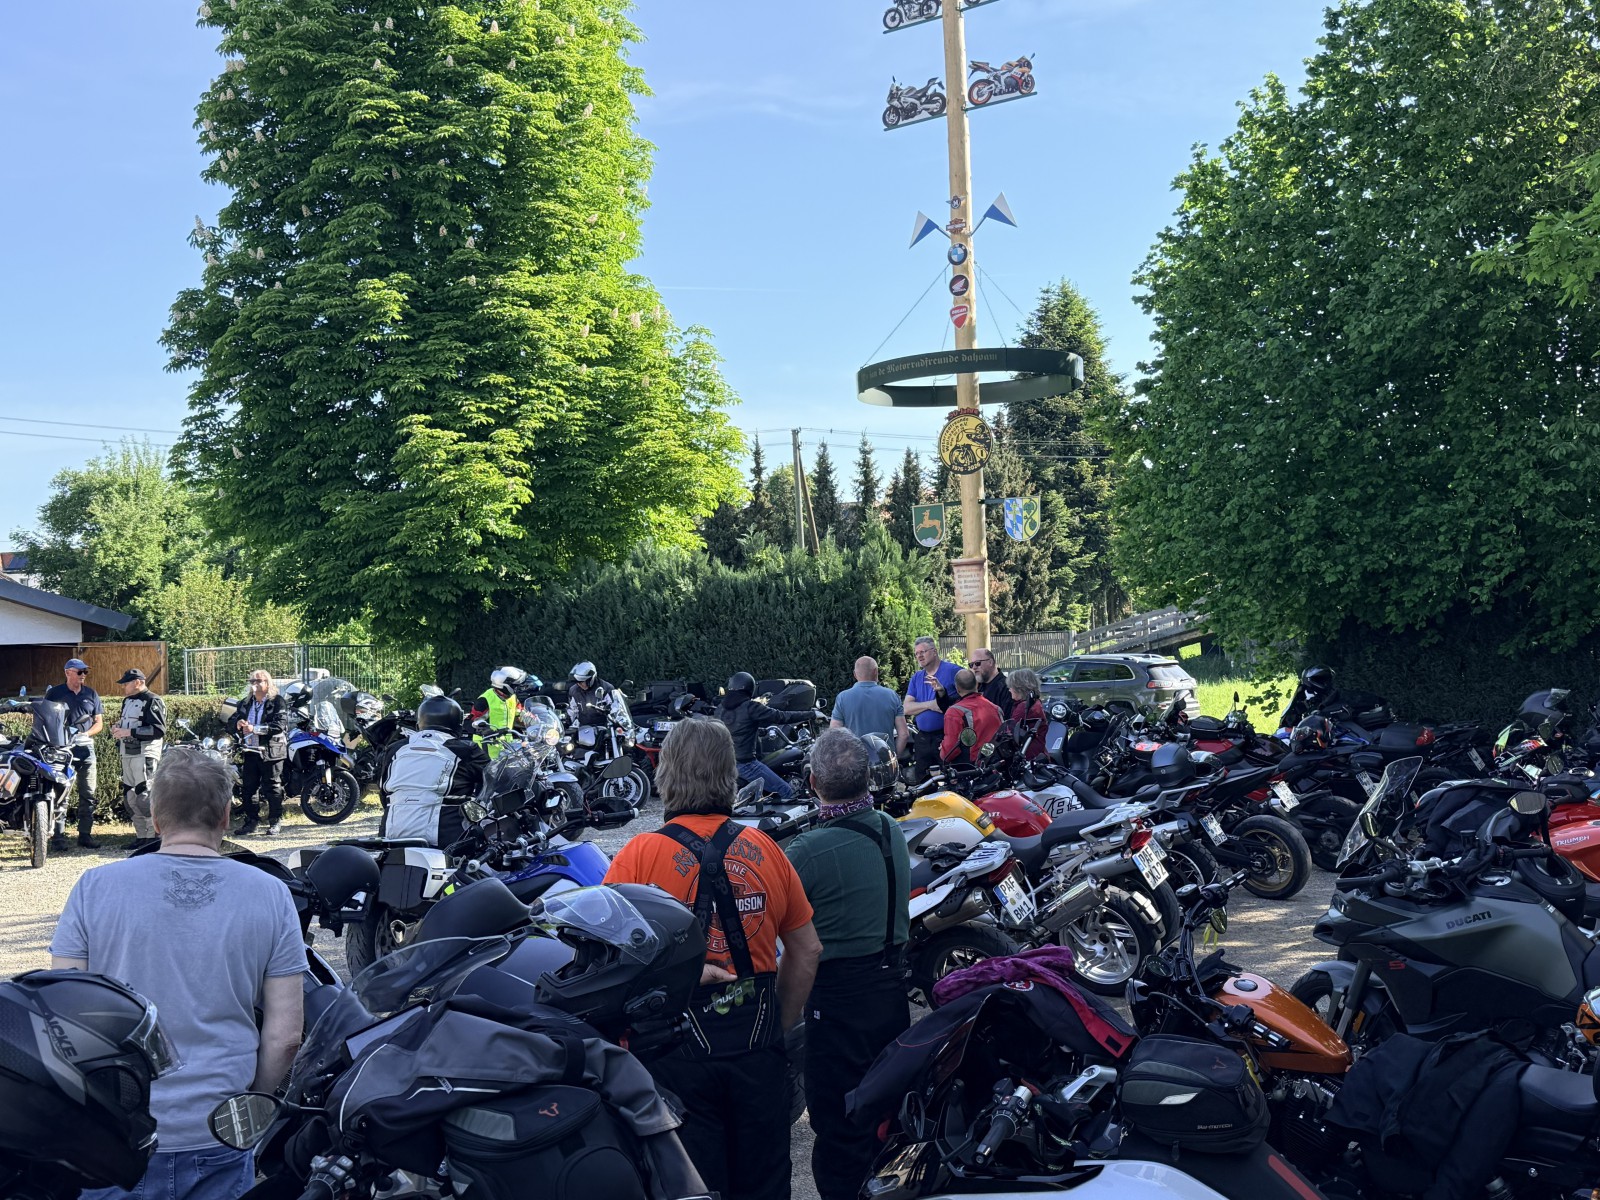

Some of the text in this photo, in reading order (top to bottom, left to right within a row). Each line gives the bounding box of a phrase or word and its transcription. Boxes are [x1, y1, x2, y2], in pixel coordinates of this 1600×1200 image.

[887, 355, 959, 373] Motorradfreunde
[961, 353, 998, 362] dahoam
[1555, 835, 1590, 846] TRIUMPH
[1138, 847, 1154, 868] PAF
[1000, 876, 1016, 895] PAF
[1446, 910, 1492, 930] DUCATI
